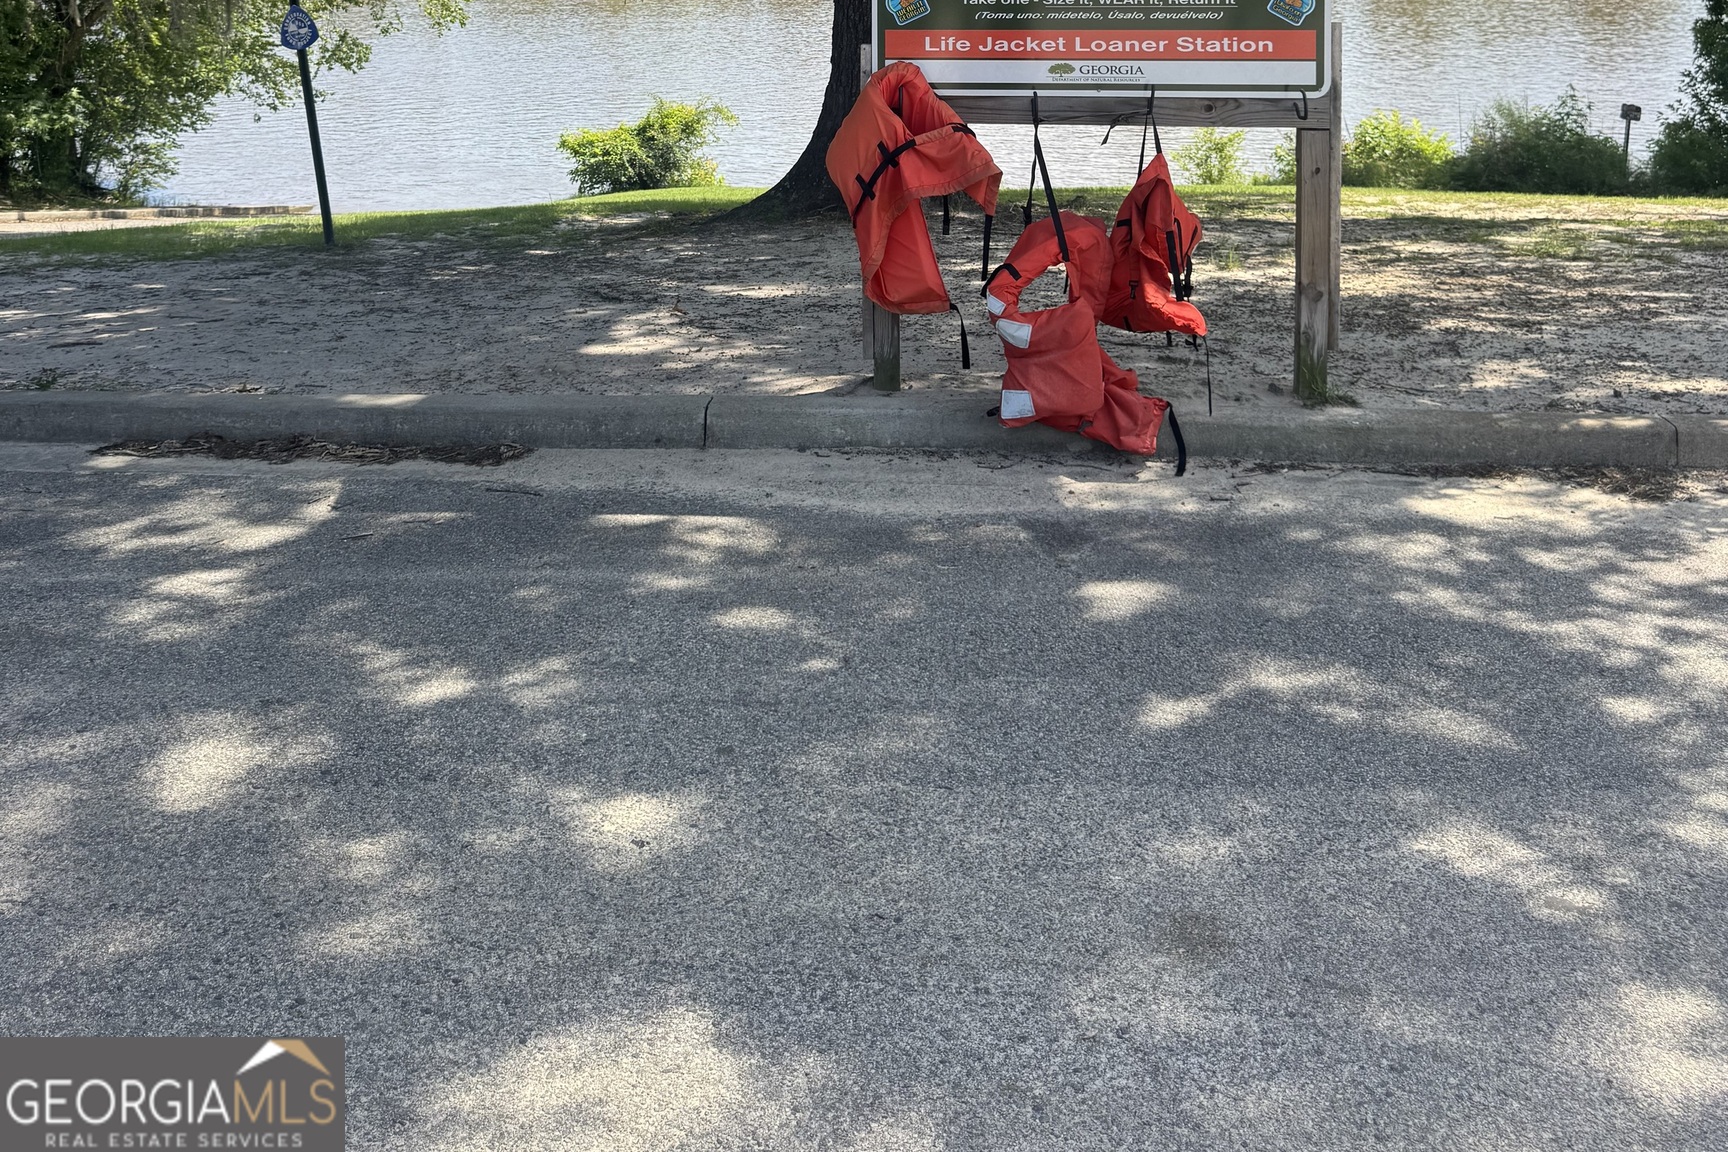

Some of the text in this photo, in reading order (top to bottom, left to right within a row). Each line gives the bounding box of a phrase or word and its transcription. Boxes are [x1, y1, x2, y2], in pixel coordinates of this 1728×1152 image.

[974, 11, 1015, 20] (Toma
[1046, 11, 1104, 20] mídetelo,
[1108, 9, 1146, 20] Úsalo,
[1149, 11, 1224, 20] devuélvelo)
[924, 36, 1273, 53] Life Jacket Loaner Station
[1079, 64, 1145, 75] GEORGIA
